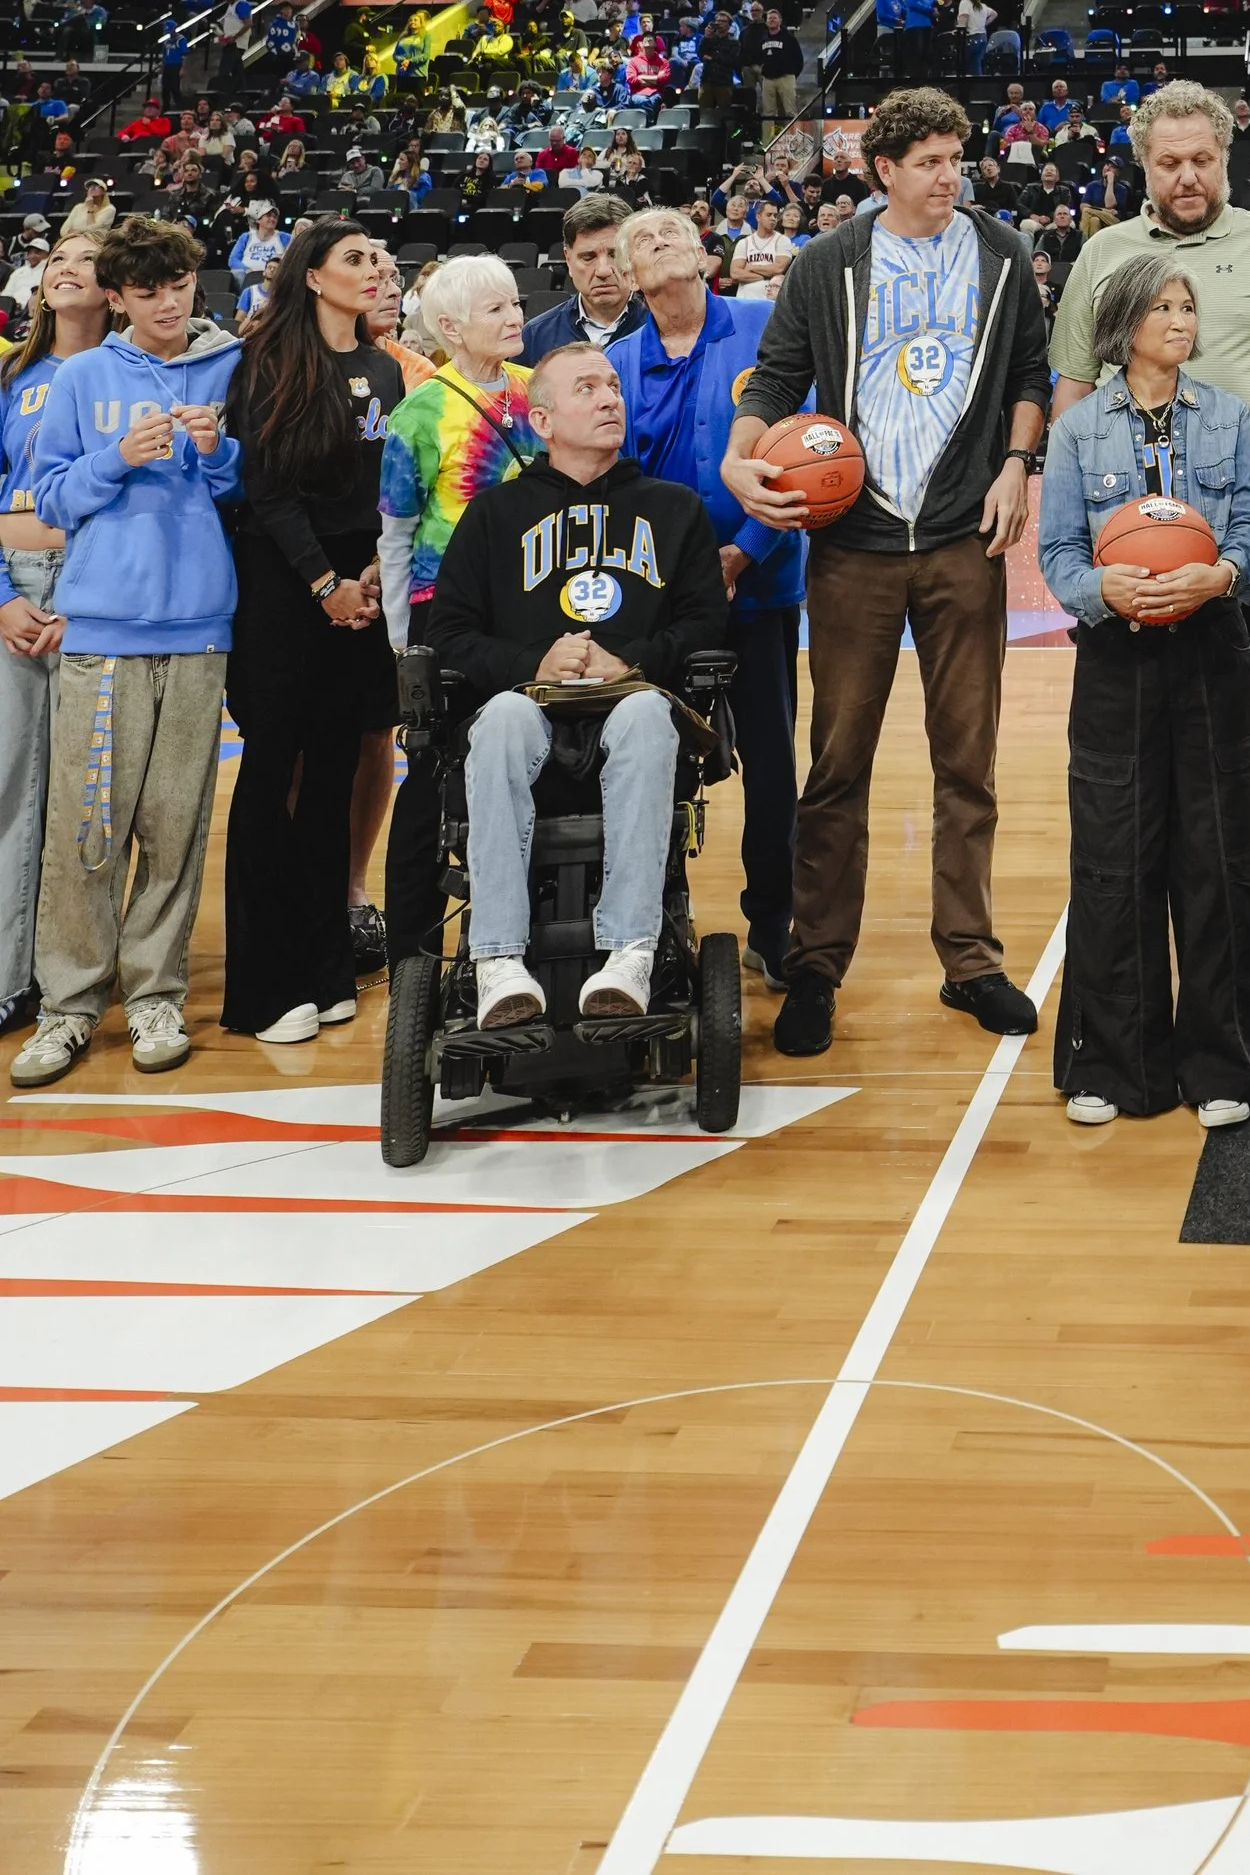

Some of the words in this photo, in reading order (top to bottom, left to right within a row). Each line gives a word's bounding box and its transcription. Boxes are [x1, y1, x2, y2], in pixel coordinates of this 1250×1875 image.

[910, 345, 941, 371] 32
[521, 504, 662, 592] UCLA
[574, 579, 607, 601] 32
